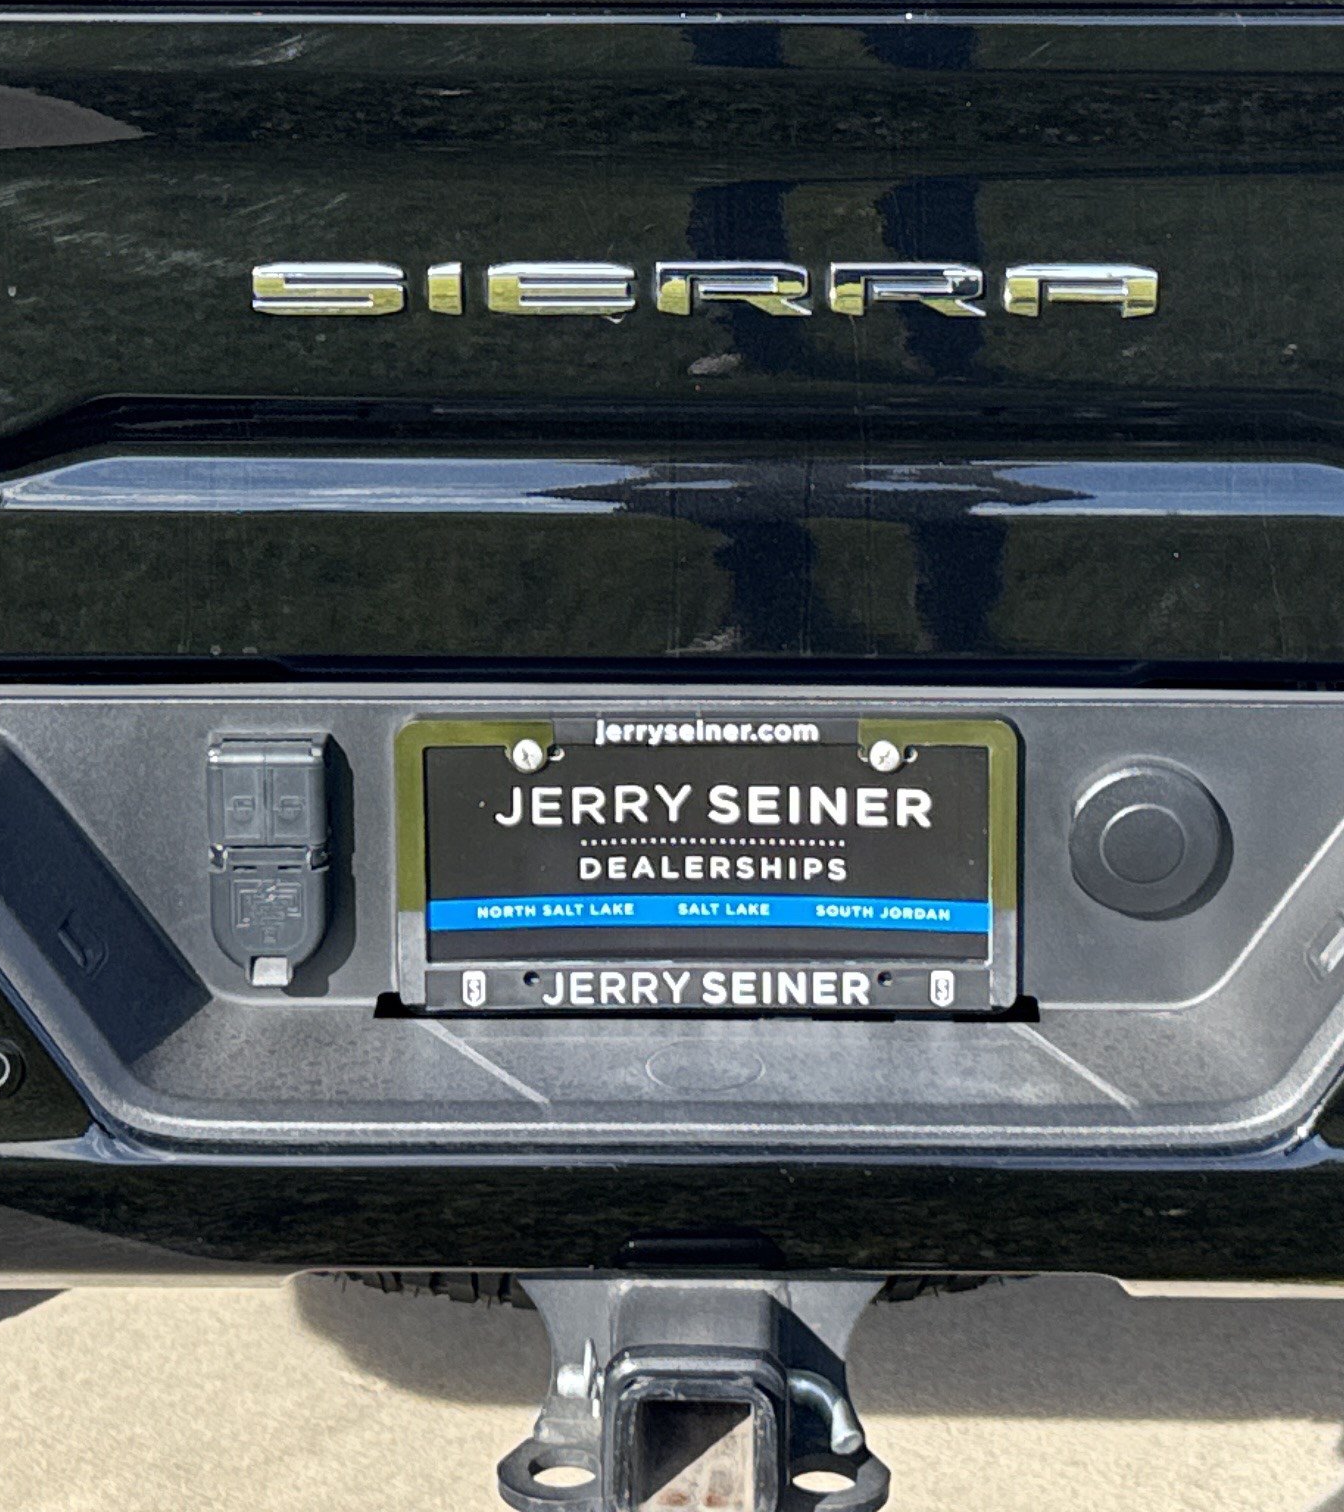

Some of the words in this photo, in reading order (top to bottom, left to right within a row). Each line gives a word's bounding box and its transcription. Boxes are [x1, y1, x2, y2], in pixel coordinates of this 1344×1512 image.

[252, 261, 1159, 318] SIERRA
[595, 718, 820, 746] jerryseiner.com
[494, 784, 692, 828] JERRY
[707, 784, 934, 829] SEINER
[579, 854, 848, 882] DEALERSHIPS
[476, 904, 536, 920] NORTH
[541, 902, 584, 918] SALT
[589, 901, 635, 917] LAKE
[677, 901, 719, 917] SALT
[725, 901, 771, 917] LAKE
[815, 903, 874, 919] SOUTH
[879, 905, 951, 922] JORDAN
[542, 970, 691, 1006] JERRY
[702, 970, 872, 1007] SEINER
